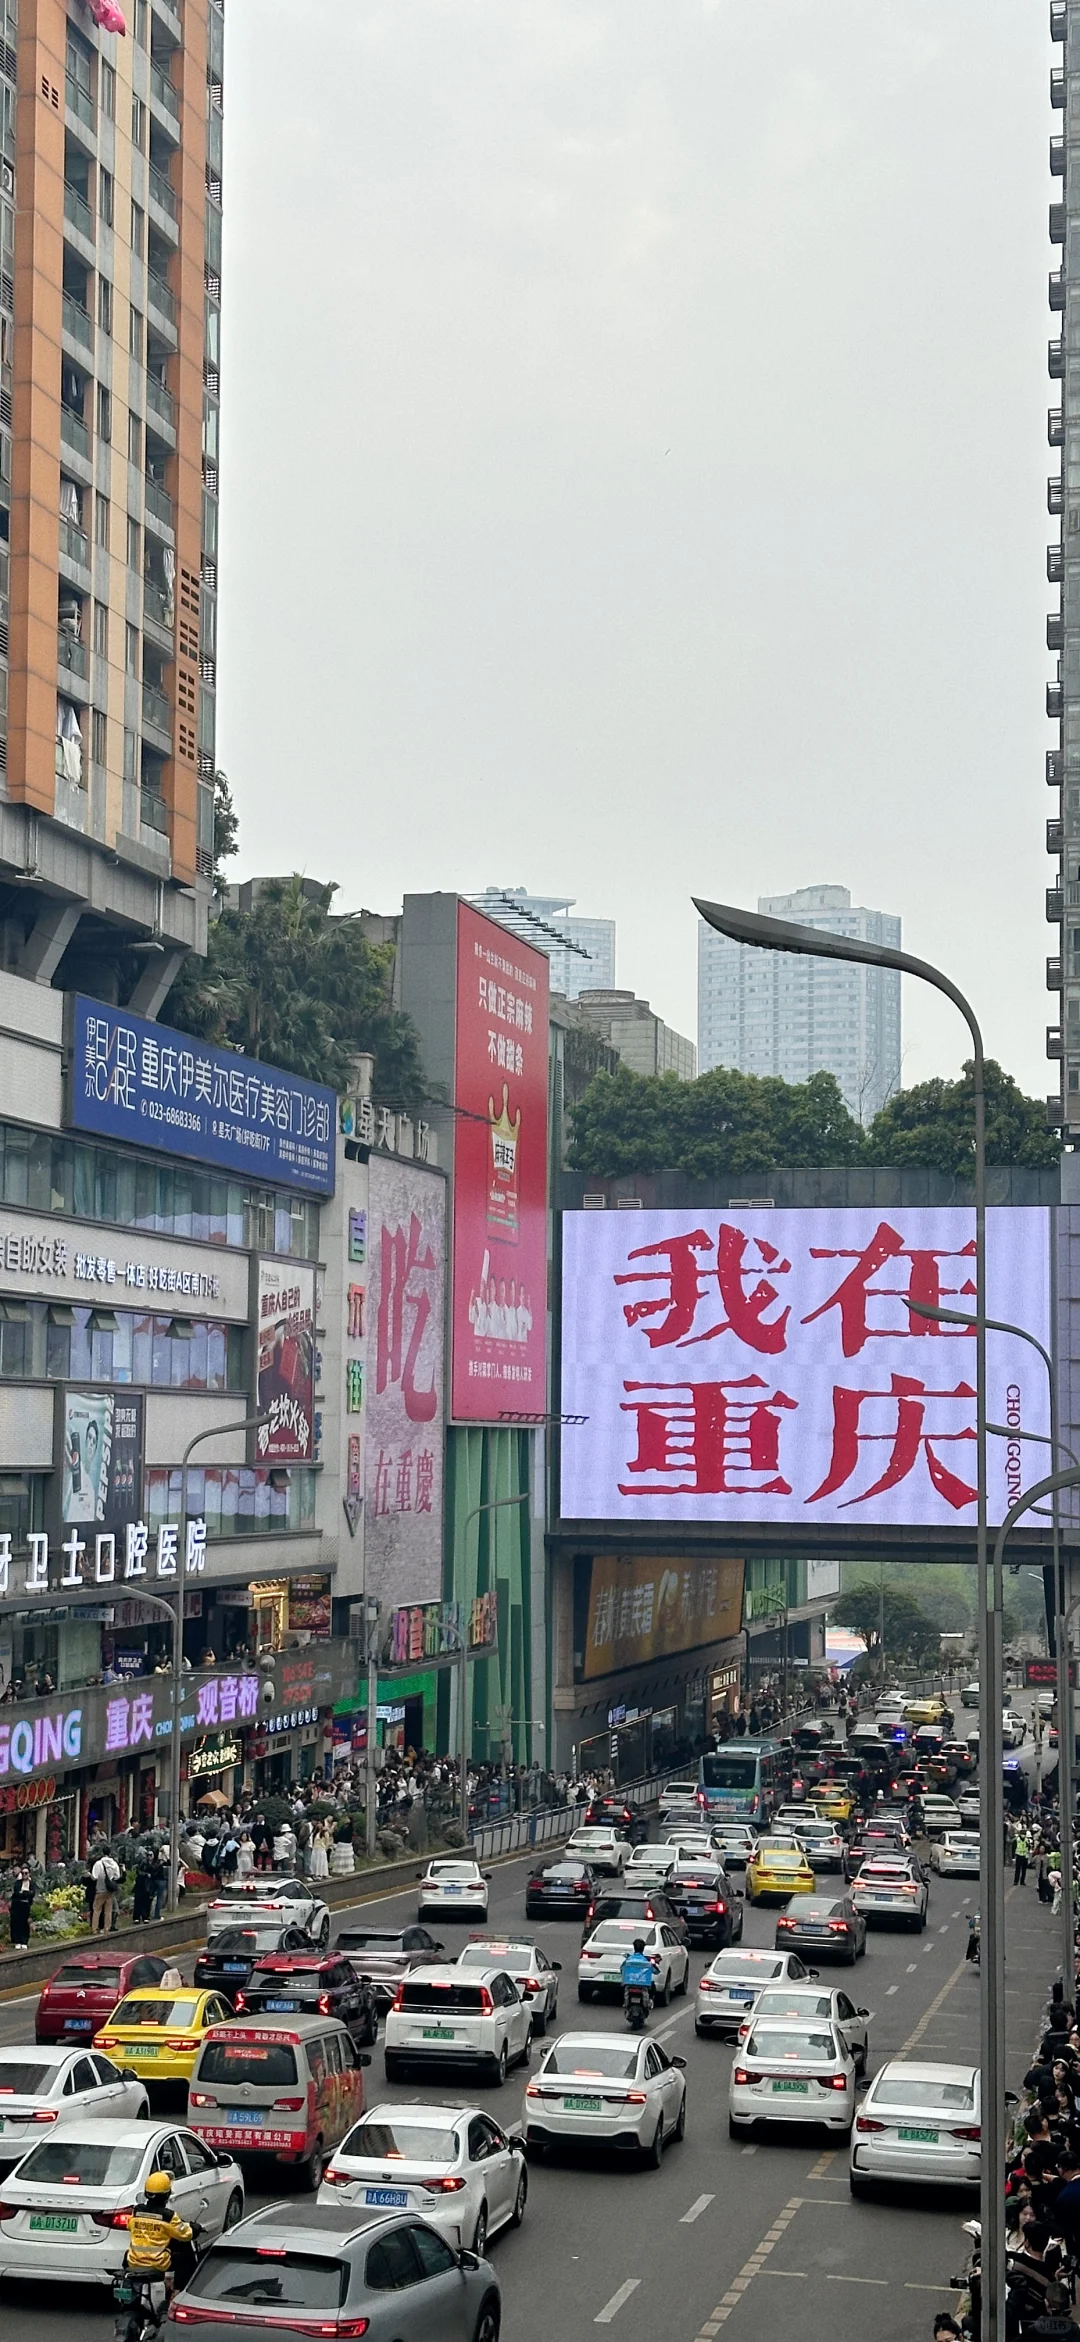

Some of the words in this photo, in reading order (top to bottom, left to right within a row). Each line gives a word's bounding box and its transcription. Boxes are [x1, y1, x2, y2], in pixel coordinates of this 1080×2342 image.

[479, 976, 533, 1035] 只做正宗麻辣
[85, 1016, 96, 1097] 伊美尔
[95, 1061, 137, 1111] CARE
[141, 1037, 330, 1143] 重庆伊美尔医疗美容门诊部
[149, 1101, 202, 1132] 023-68683366
[359, 1099, 430, 1162] 星天广场
[0, 1233, 68, 1276] 自助女装
[75, 1252, 145, 1288] 批发零售一体店
[377, 1211, 437, 1422] 吃
[614, 1221, 978, 1358] 我在
[618, 1373, 988, 1509] 重庆
[105, 1692, 154, 1751] 重庆
[197, 1675, 259, 1726] 观音桥
